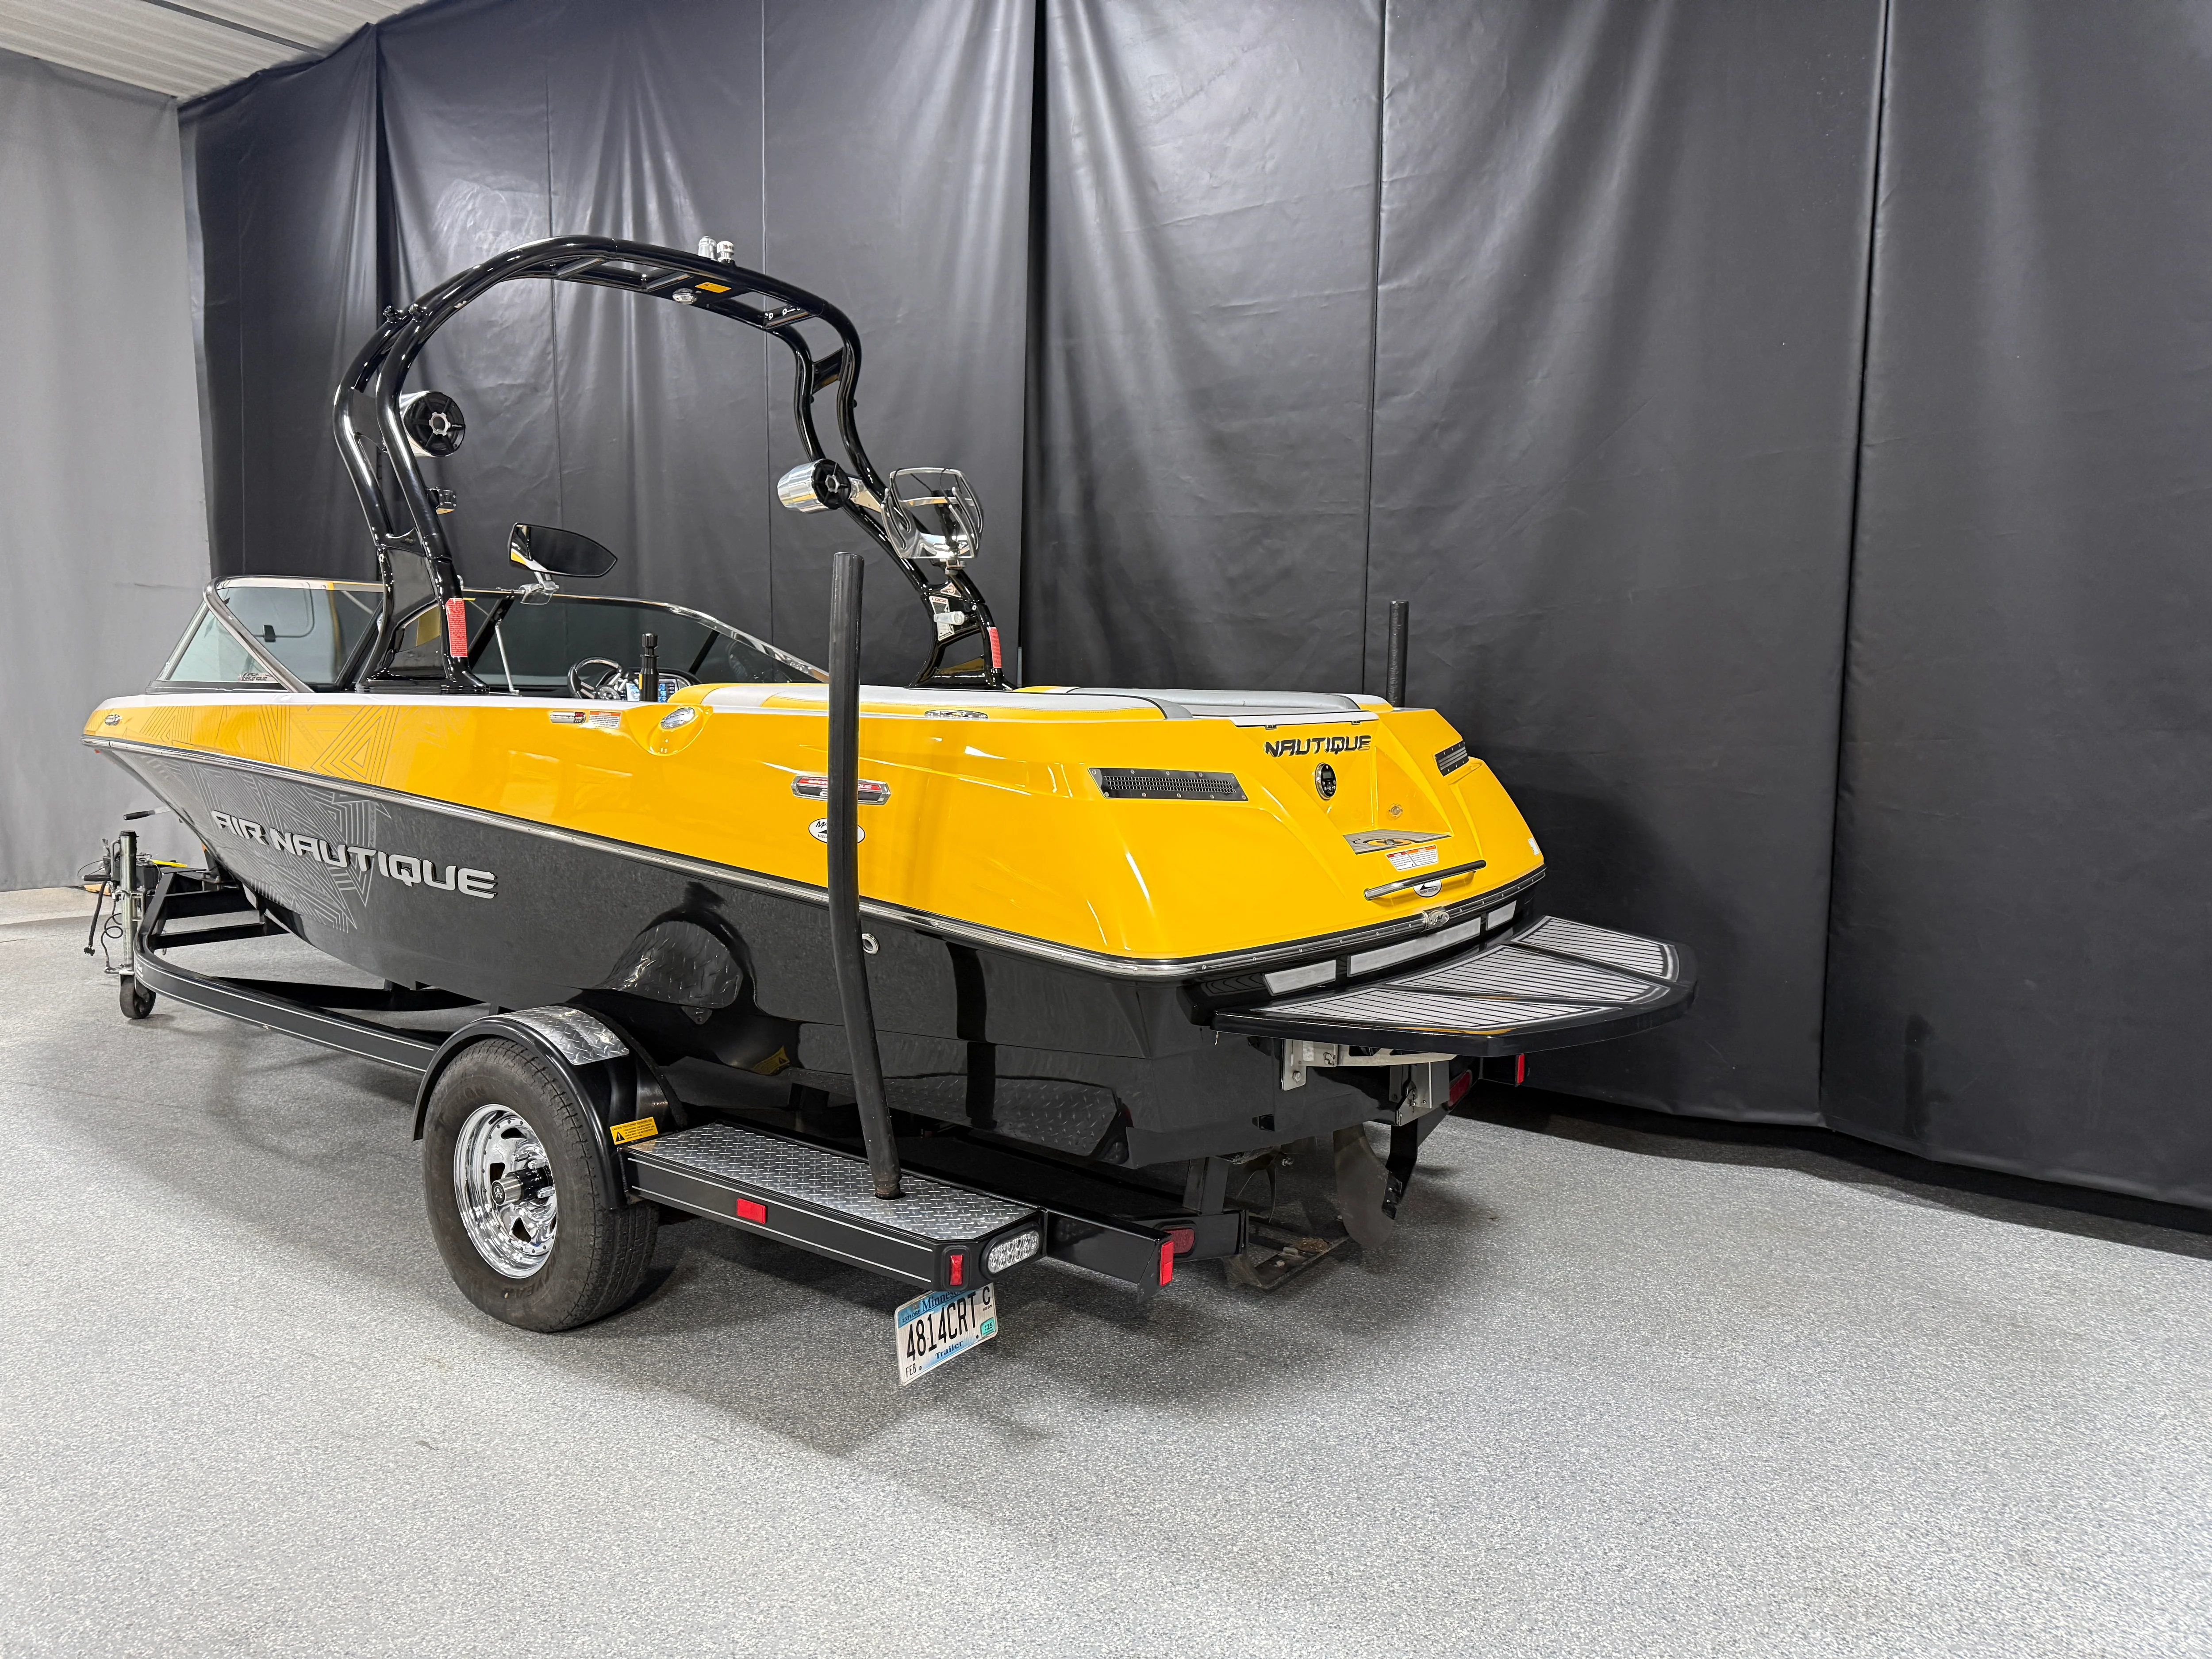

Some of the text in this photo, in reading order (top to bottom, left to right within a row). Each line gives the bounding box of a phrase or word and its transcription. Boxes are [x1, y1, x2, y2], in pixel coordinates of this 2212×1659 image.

[1263, 735, 1371, 757] NAUTIQUE
[211, 810, 498, 899] AIR NAUTIQUE
[983, 1286, 991, 1305] C
[902, 1309, 921, 1323] EXPLORE
[907, 1291, 976, 1361] 4814CRT
[935, 1340, 964, 1359] Trailer
[906, 1363, 917, 1378] FEB
